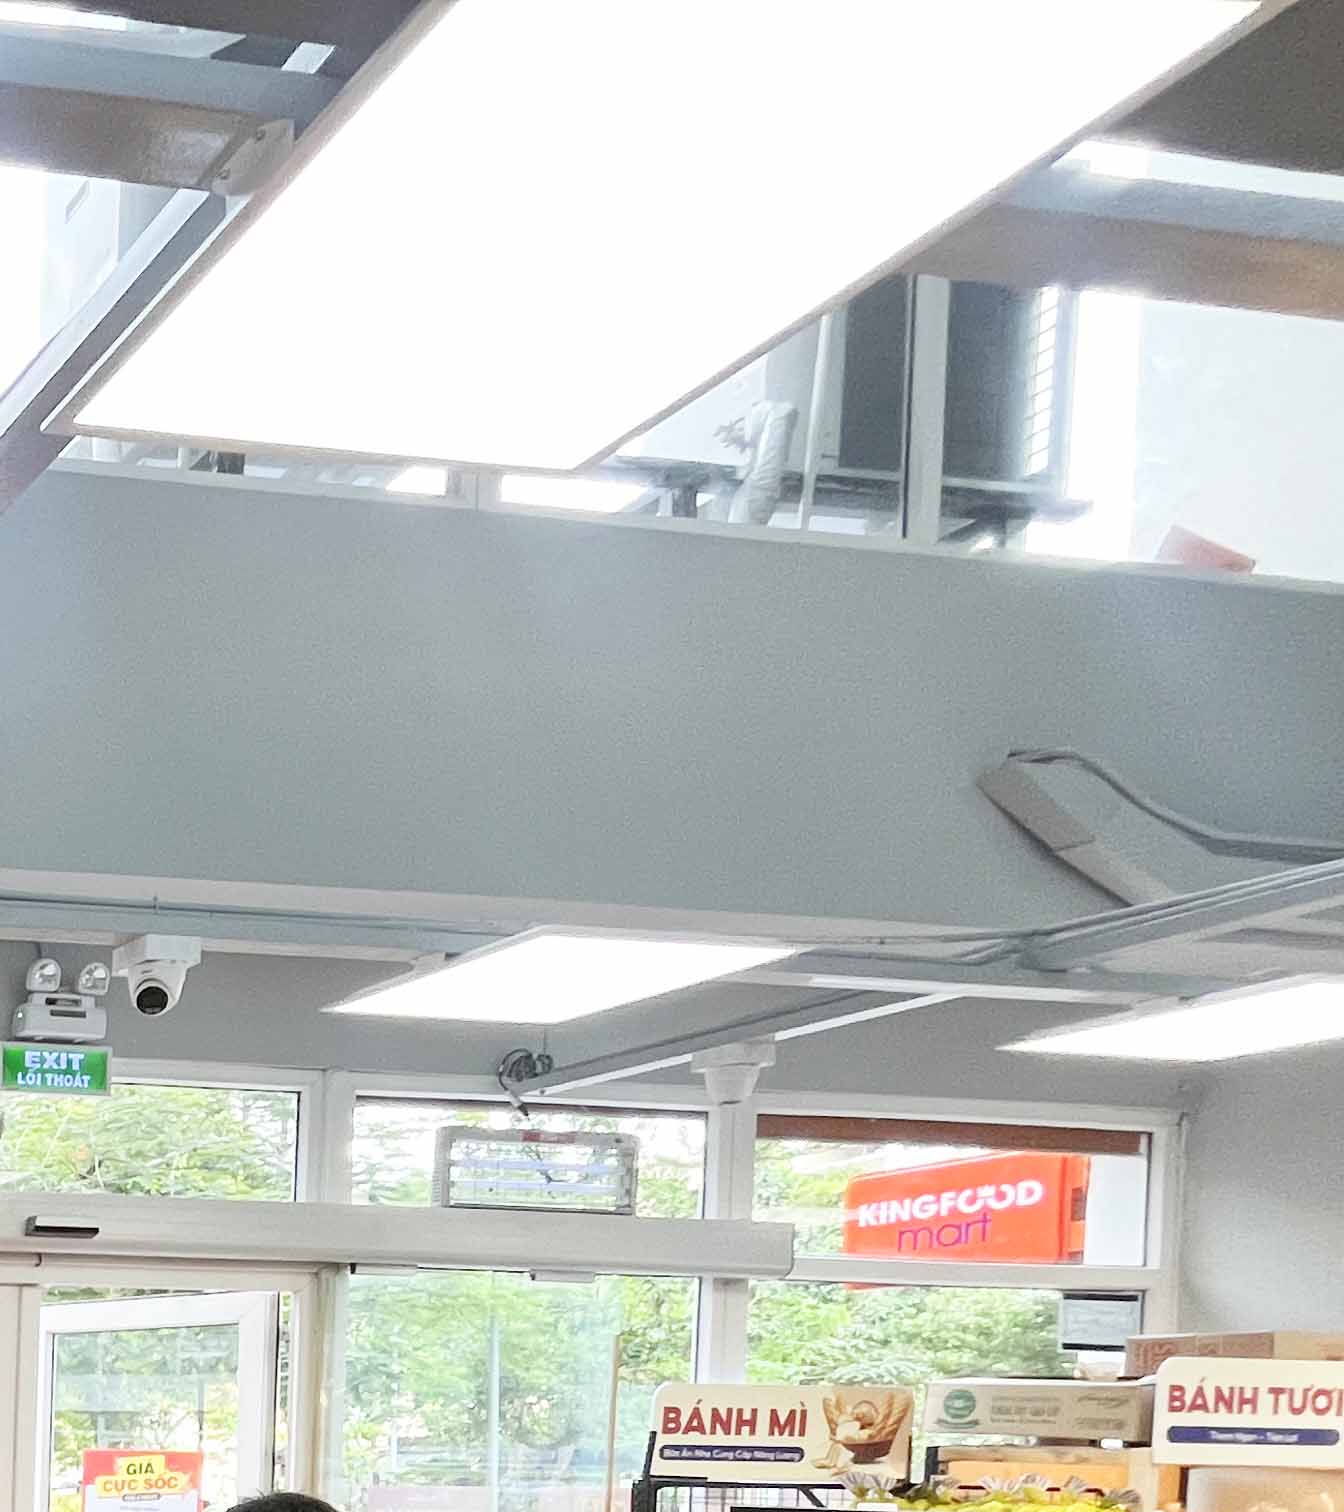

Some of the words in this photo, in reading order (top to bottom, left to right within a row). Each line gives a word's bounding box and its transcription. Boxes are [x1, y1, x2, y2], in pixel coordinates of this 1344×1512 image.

[17, 1068, 41, 1086] LỐI
[45, 1071, 91, 1088] THOÁT
[25, 1051, 84, 1070] EXIT
[858, 1180, 1044, 1227] KINGFOOD
[897, 1212, 992, 1251] mart
[1167, 1377, 1259, 1415] BÁNH
[662, 1399, 758, 1436] BÁNH
[768, 1401, 808, 1437] MÌ
[127, 1461, 155, 1476] GIÁ
